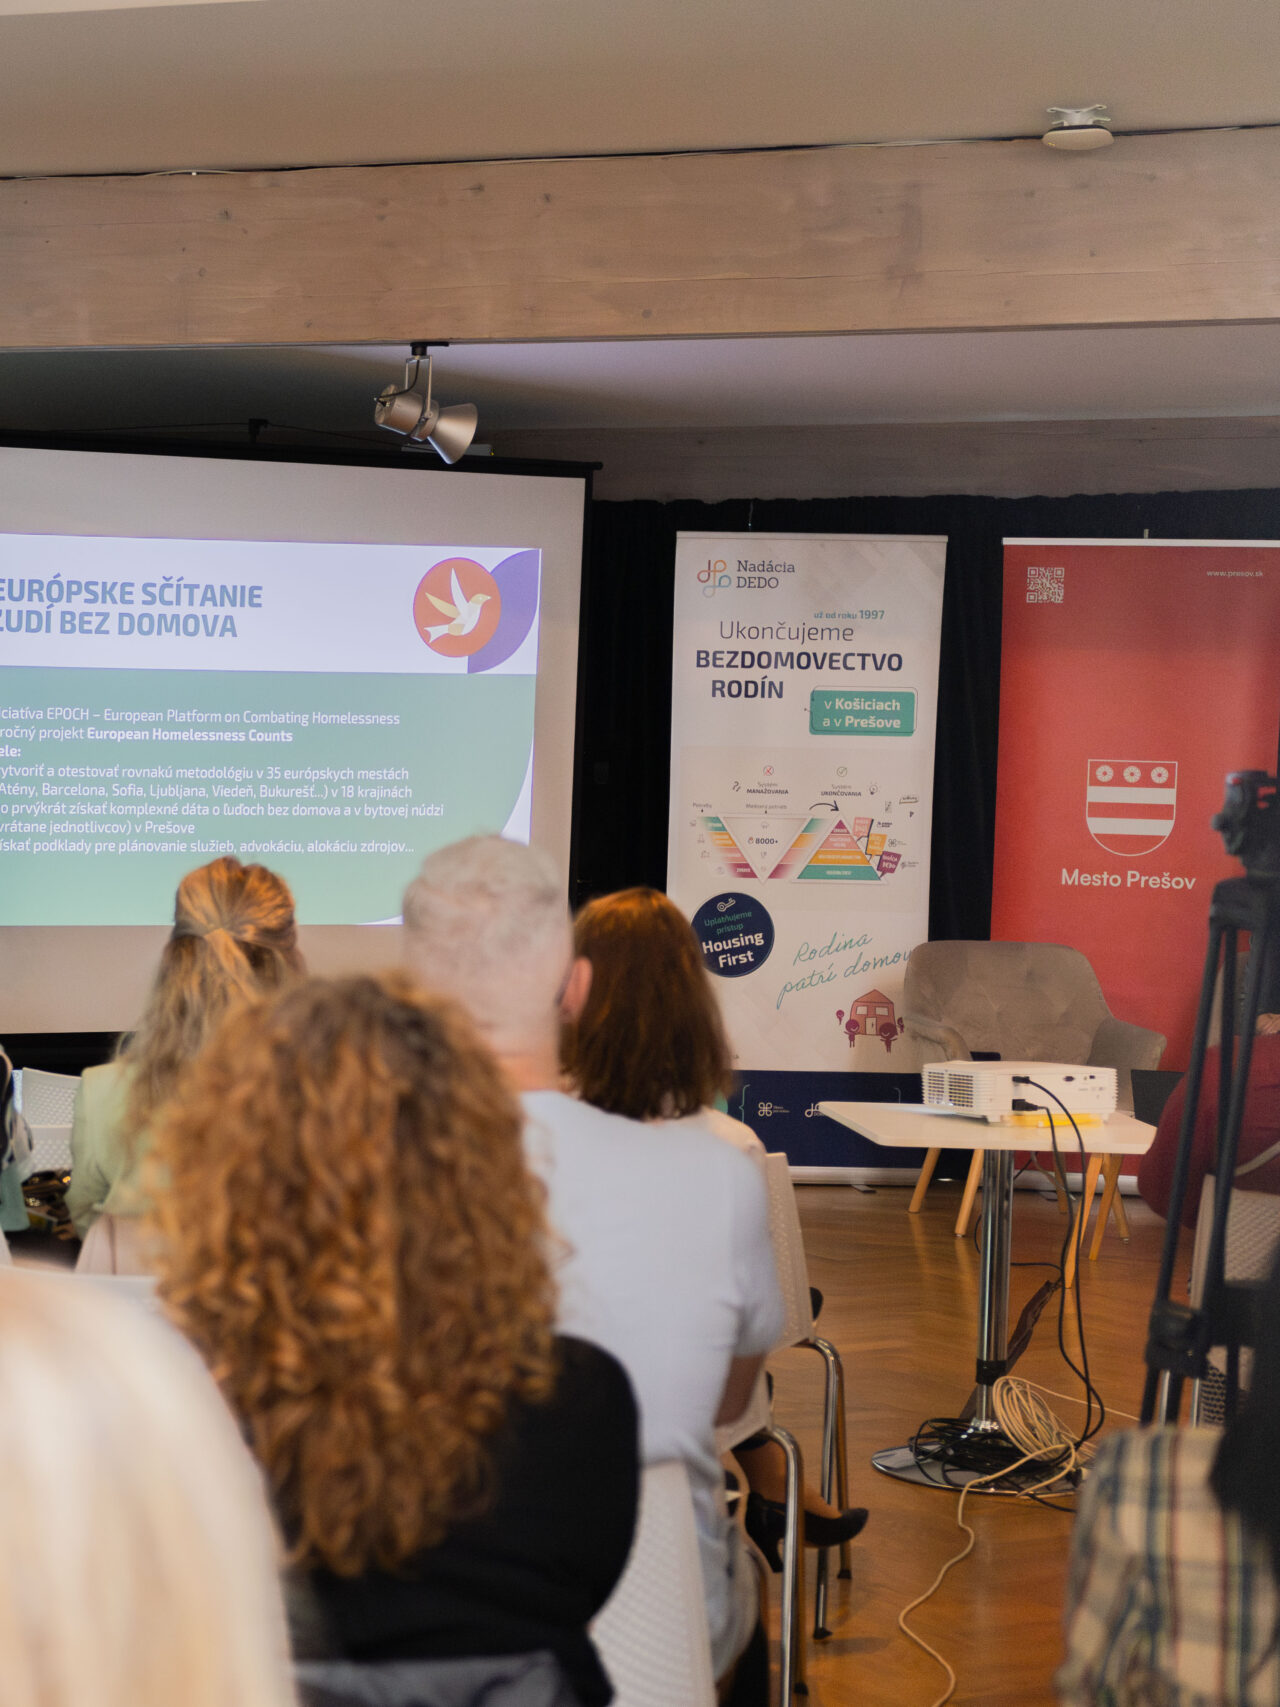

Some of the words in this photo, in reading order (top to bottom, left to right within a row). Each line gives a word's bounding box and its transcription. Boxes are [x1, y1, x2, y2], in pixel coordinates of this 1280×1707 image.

[736, 559, 795, 573] Nadácia
[141, 575, 264, 608] SČÍTANIE
[736, 576, 779, 589] DEDO
[60, 610, 111, 635] BEZ
[118, 612, 238, 638] DOMOVA
[858, 609, 885, 620] 1997
[720, 620, 854, 645] Ukončujeme
[696, 649, 903, 672] BEZDOMOVECTVO
[711, 675, 784, 699] RODÍN
[824, 700, 832, 710] v
[835, 697, 901, 712] Košiciach
[47, 707, 90, 721] EPOCH
[104, 709, 164, 725] European
[167, 709, 221, 723] Platform
[224, 712, 240, 723] on
[243, 710, 309, 727] Combating
[312, 711, 401, 725] Homelessness
[822, 717, 830, 727] a
[833, 717, 842, 727] v
[844, 714, 901, 729] Prešove
[39, 726, 85, 743] projekt
[87, 727, 149, 743] European
[152, 728, 246, 742] Homelessness
[248, 729, 294, 742] Counts
[47, 767, 55, 777] a
[58, 764, 120, 778] otestovať
[122, 765, 173, 779] rovnakú
[175, 767, 253, 782] metodológiu
[256, 770, 264, 779] v
[266, 766, 281, 779] 35
[284, 767, 354, 783] európskych
[357, 767, 409, 780] mestách
[42, 783, 109, 798] Barcelona,
[112, 783, 146, 798] Sofia,
[150, 783, 209, 800] Ljubljana,
[212, 784, 257, 799] Viedeň,
[331, 788, 338, 798] v
[341, 785, 355, 798] 18
[357, 785, 413, 801] krajinách
[11, 800, 67, 817] prvýkrát
[69, 801, 107, 815] získať
[109, 802, 179, 819] komplexné
[181, 803, 210, 816] dáta
[212, 806, 221, 816] o
[223, 802, 265, 817] ľuďoch
[267, 803, 289, 817] bez
[292, 803, 341, 817] domova
[344, 807, 352, 817] a
[354, 807, 362, 817] v
[364, 804, 409, 820] bytovej
[411, 803, 444, 817] núdzi
[49, 820, 132, 836] jednotlivcov)
[134, 824, 142, 834] v
[144, 820, 195, 835] Prešove
[33, 839, 92, 855] podklady
[95, 842, 116, 855] pre
[118, 839, 187, 855] plánovanie
[190, 840, 237, 854] služieb,
[240, 840, 305, 855] advokáciu,
[307, 840, 358, 853] alokáciu
[360, 840, 415, 855] zdrojov...
[1061, 868, 1122, 887] Mesto
[1127, 869, 1197, 890] Prešov
[702, 932, 765, 954] Housing
[793, 931, 874, 966] Rodina
[718, 950, 755, 968] First
[776, 962, 838, 1010] patrí
